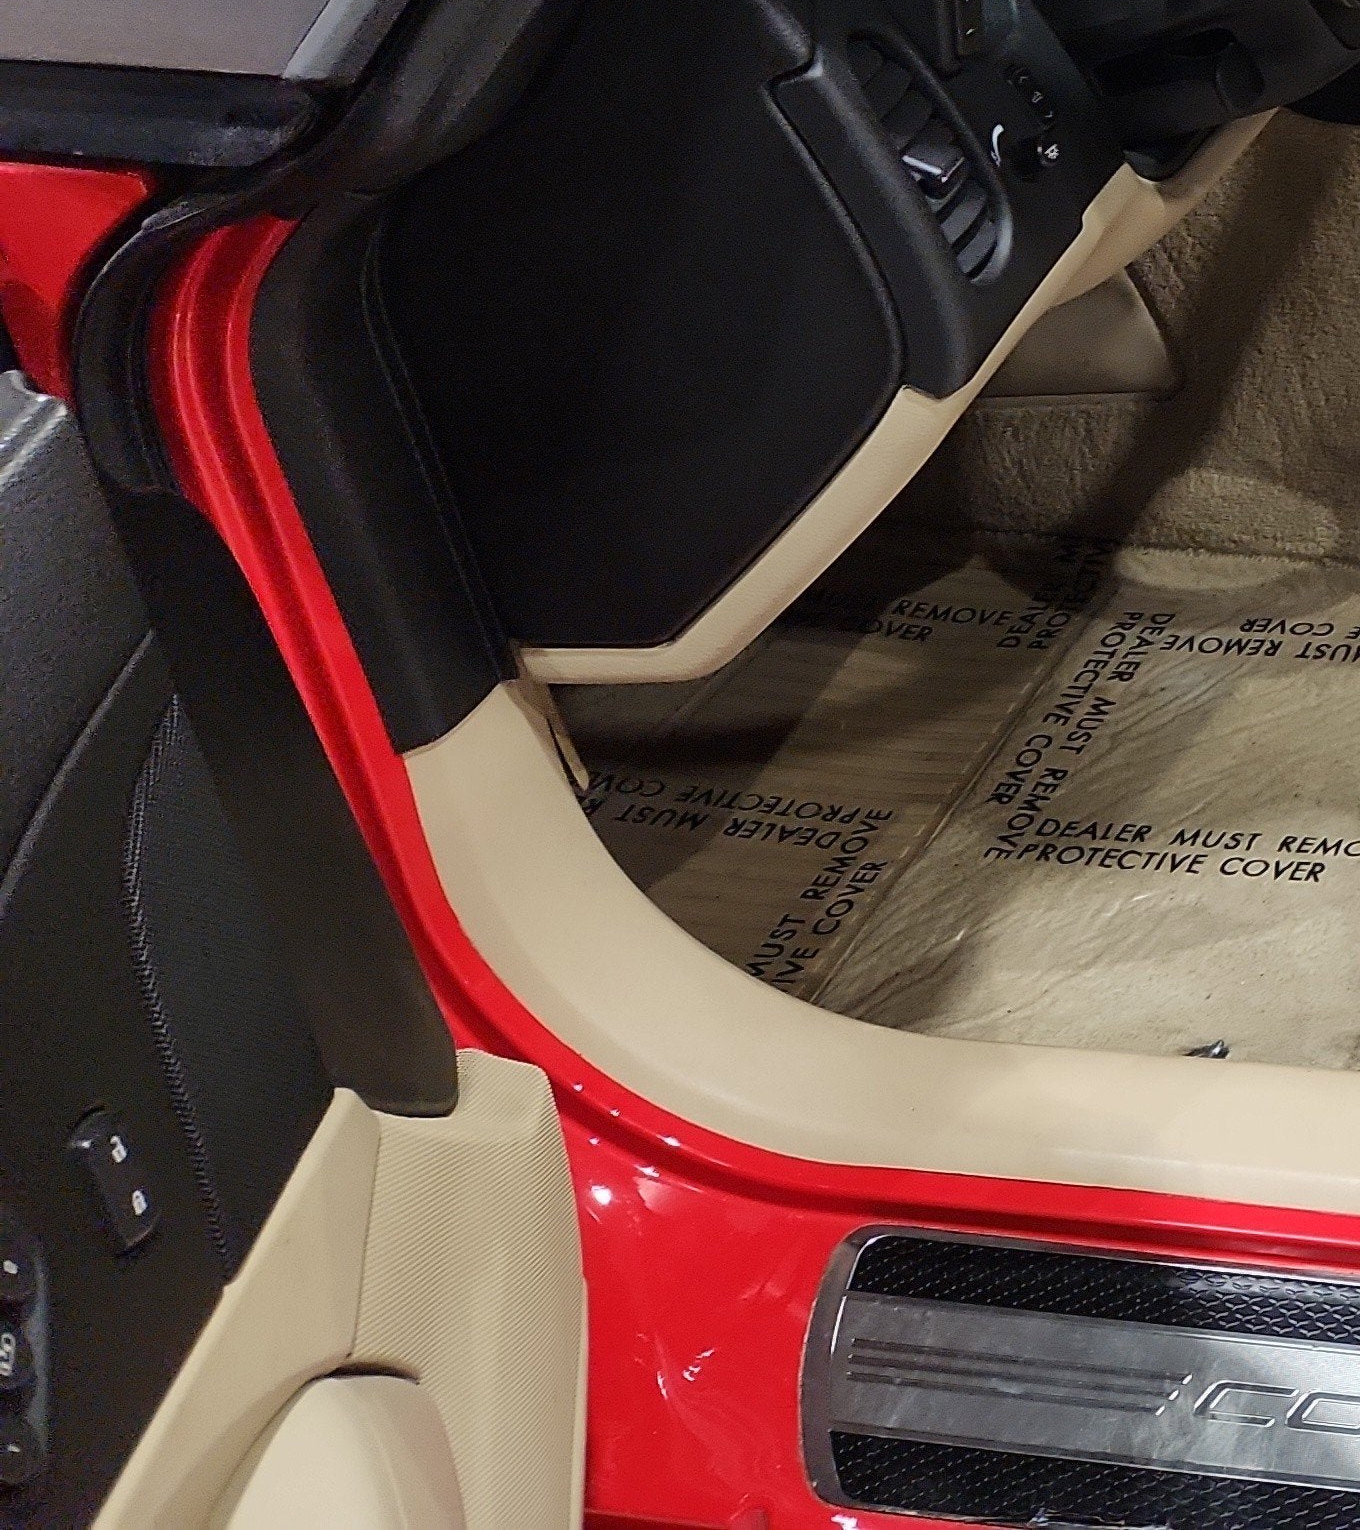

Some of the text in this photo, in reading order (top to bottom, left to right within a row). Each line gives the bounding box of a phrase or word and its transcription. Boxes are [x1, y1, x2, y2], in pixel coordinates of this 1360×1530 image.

[840, 615, 933, 641] OVER
[892, 599, 1013, 626] REMOVE
[1239, 617, 1334, 638] COVER
[1160, 632, 1282, 657] REMOVE
[984, 611, 1144, 805] PROTECTIVE COVER
[984, 612, 1175, 860] DEALER MUST REMOVE
[589, 771, 861, 826] PROTECTIVE COV
[614, 804, 711, 831] MUST
[723, 816, 841, 851] DEALER
[1036, 818, 1153, 844] DEALER
[1169, 828, 1263, 853] MUST
[801, 809, 893, 901] REMOVE
[1017, 843, 1326, 884] PROTECTIVE COVER
[812, 861, 889, 936] COVER
